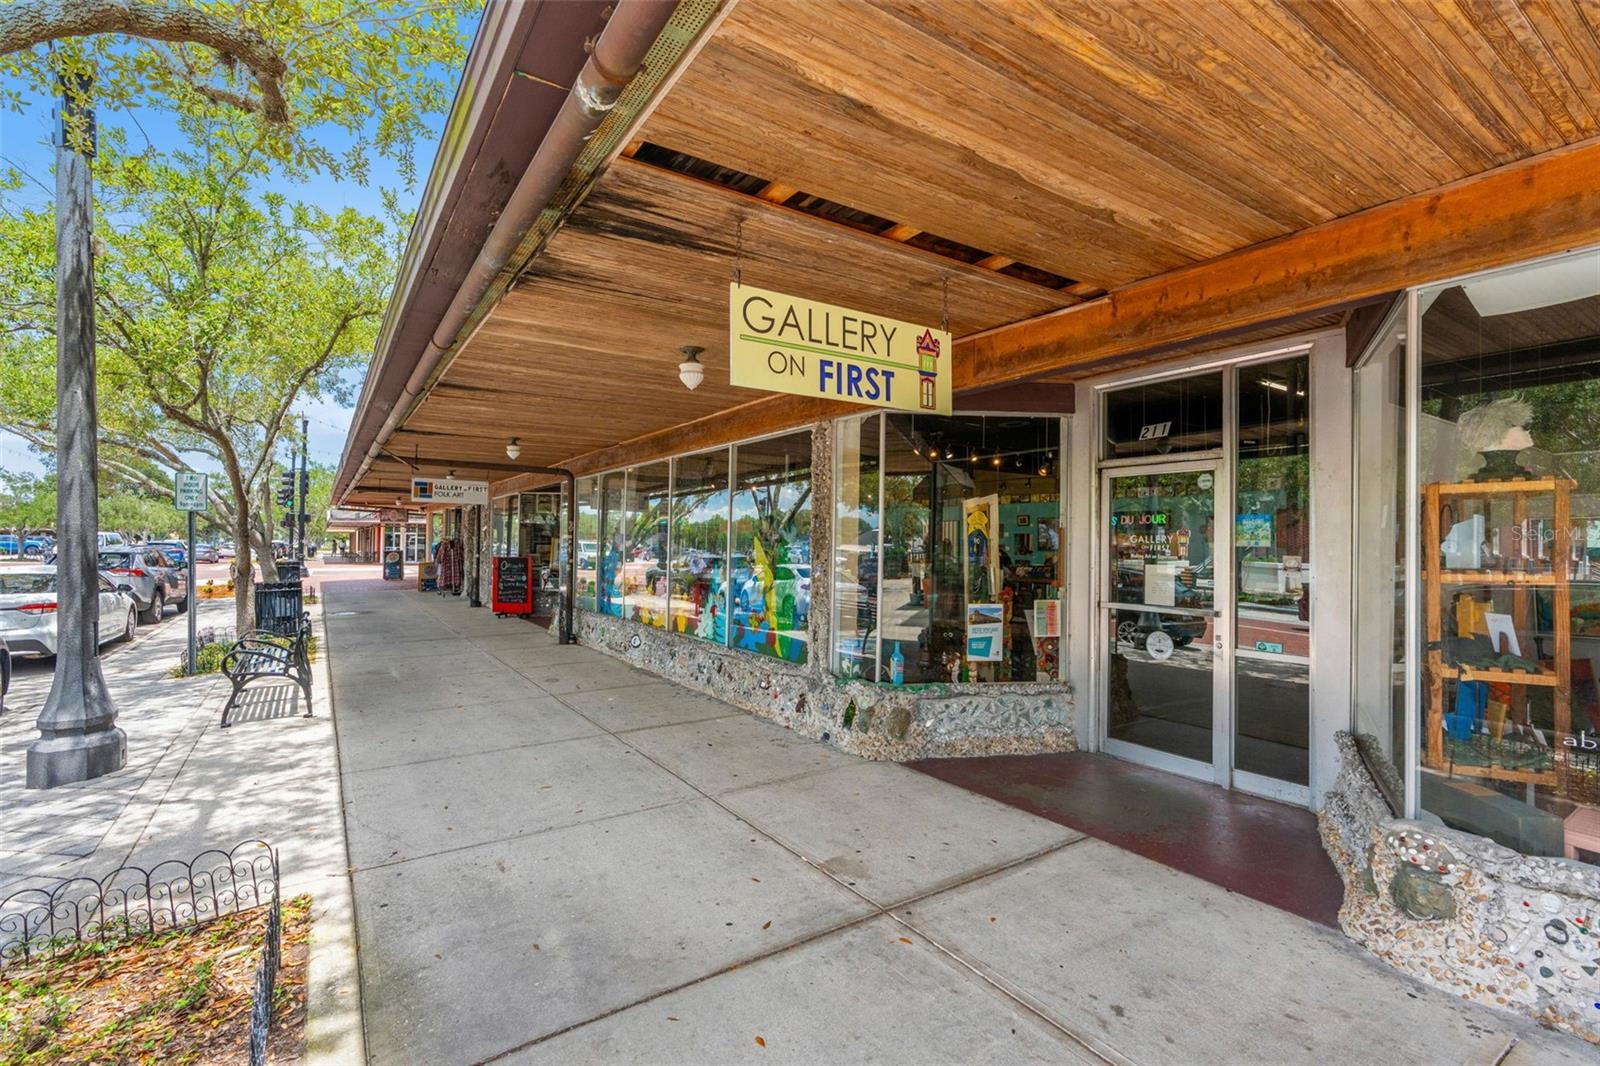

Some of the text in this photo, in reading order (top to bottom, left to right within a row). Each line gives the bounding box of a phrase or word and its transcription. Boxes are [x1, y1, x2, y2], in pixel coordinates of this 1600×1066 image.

[742, 295, 897, 357] GALLERY
[767, 350, 895, 402] ON FIRST
[1141, 423, 1168, 439] 211
[1120, 514, 1134, 525] DU
[1138, 513, 1167, 526] JOUR
[1130, 534, 1174, 544] GALLERY
